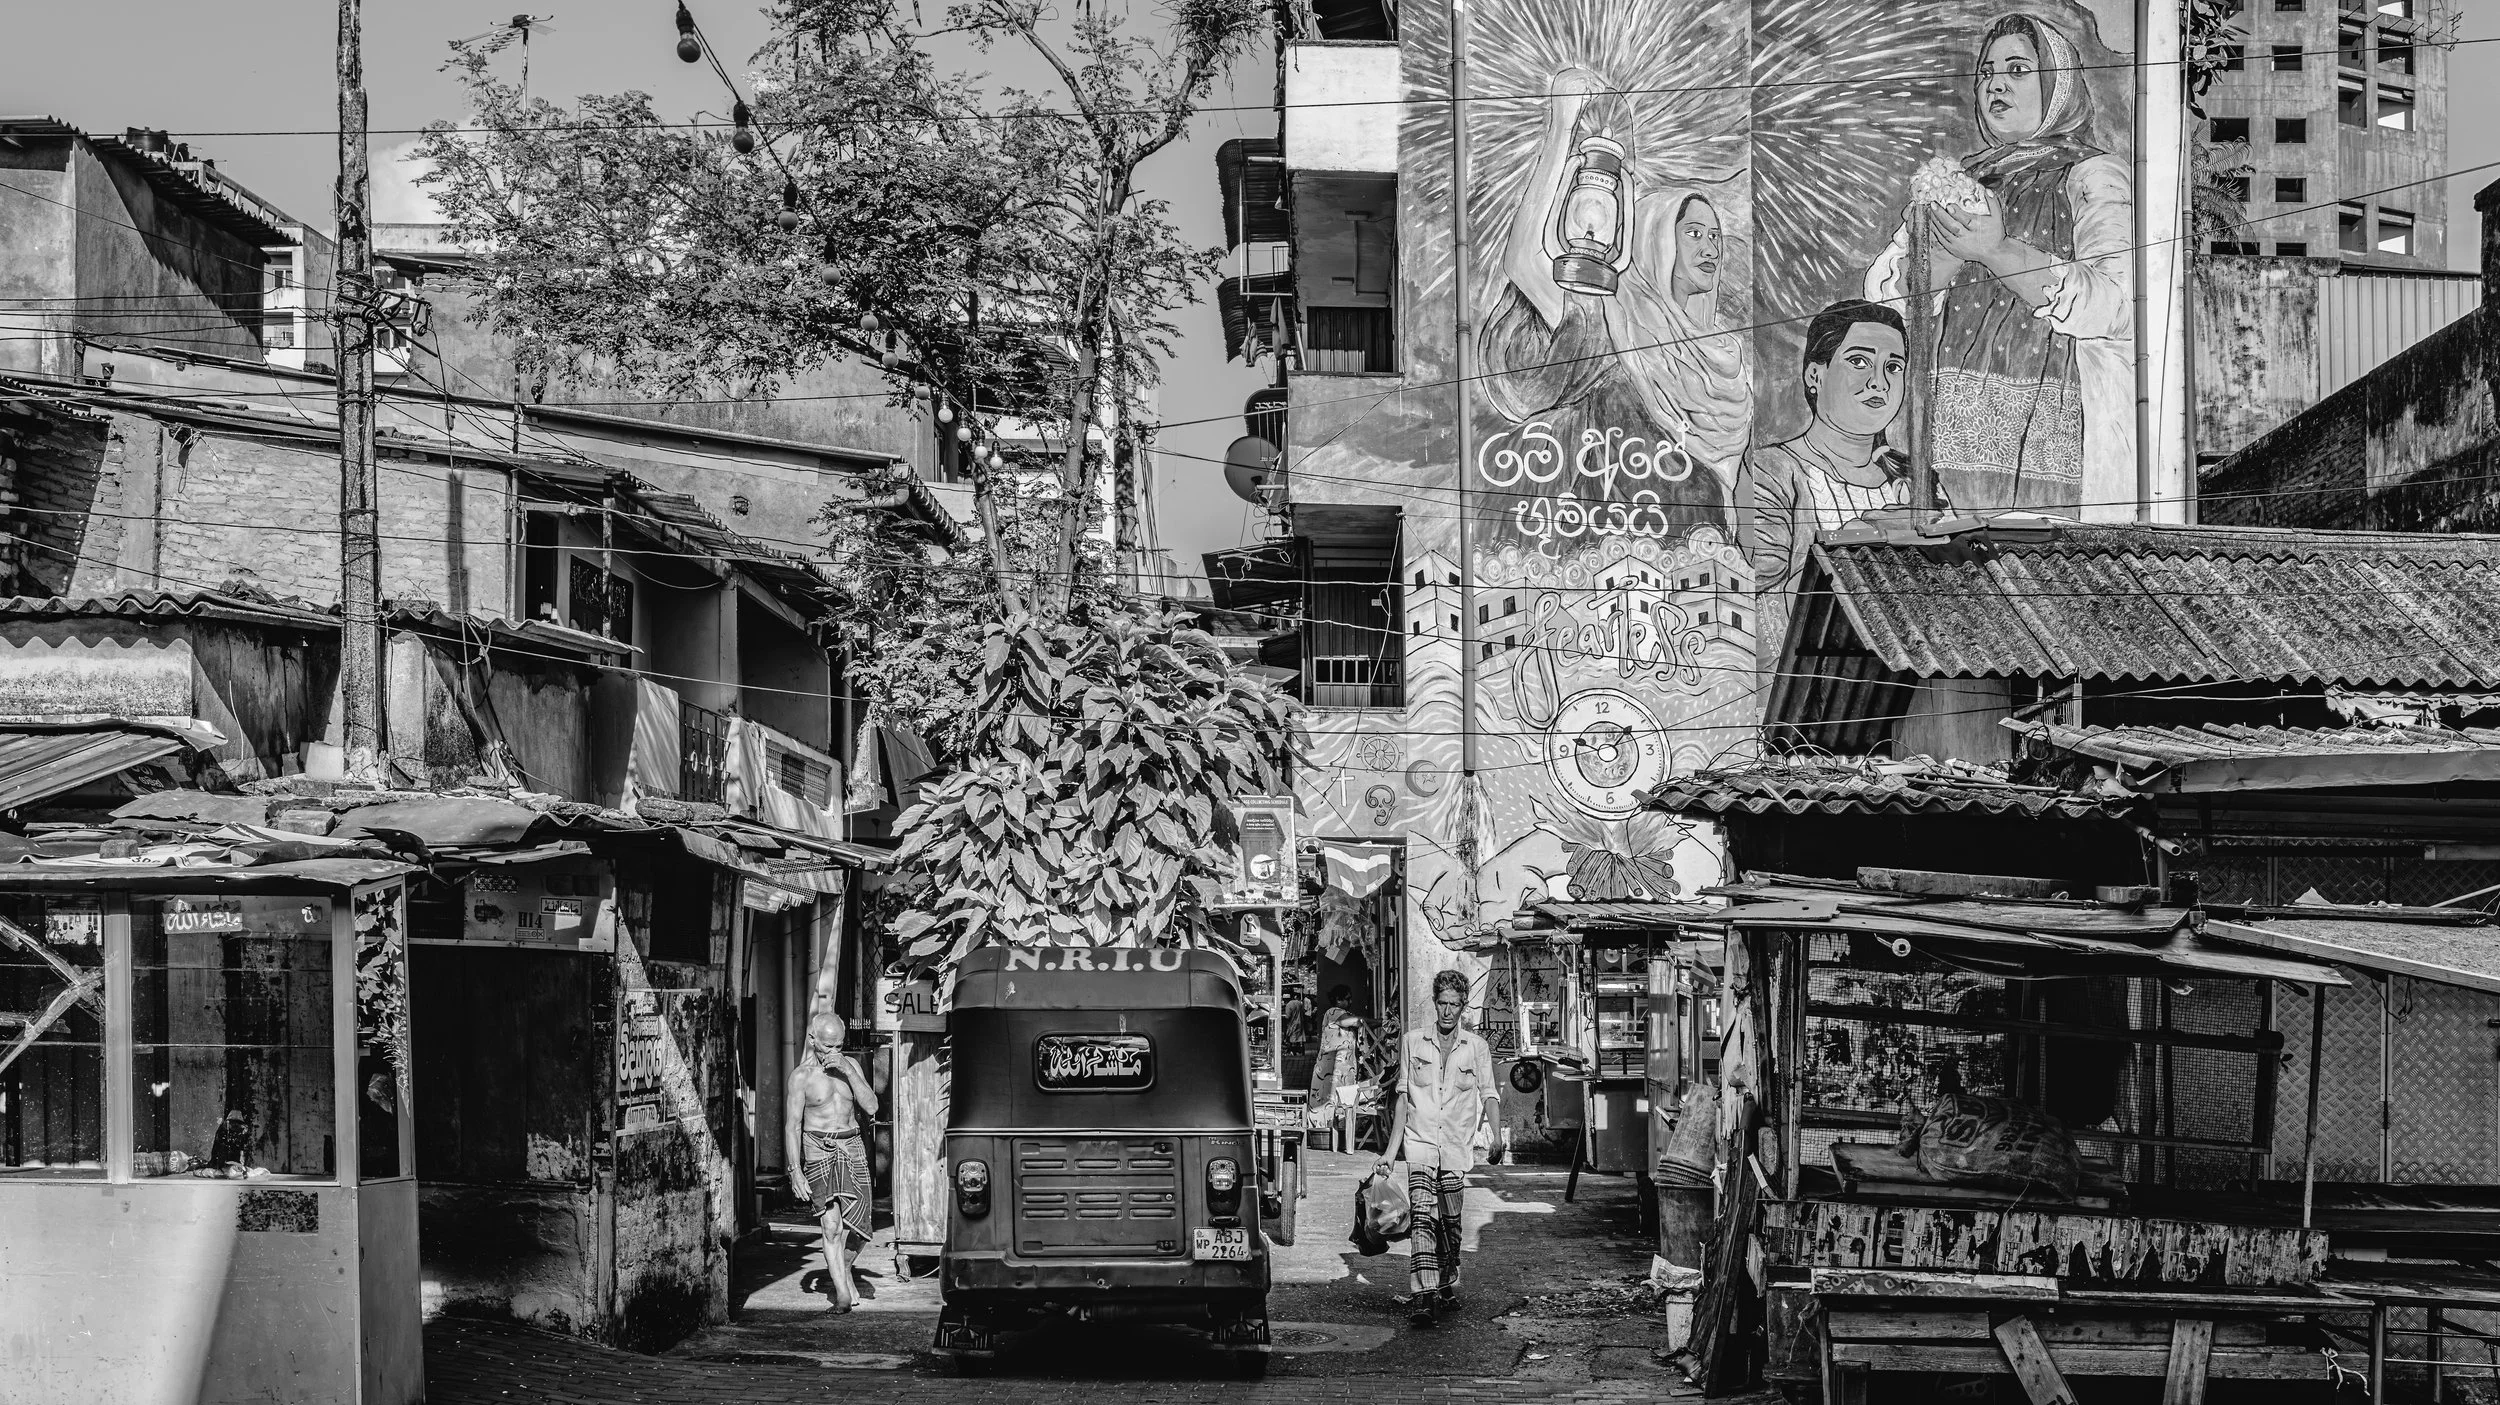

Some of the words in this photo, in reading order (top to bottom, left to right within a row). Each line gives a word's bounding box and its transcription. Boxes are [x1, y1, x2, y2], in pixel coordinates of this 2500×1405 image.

[1478, 421, 1564, 487] මේ
[1576, 420, 1693, 501] අපේ
[1594, 702, 1610, 714] 12
[1559, 745, 1570, 757] 9
[1645, 744, 1655, 756] 3
[1605, 791, 1614, 804] 6
[1196, 1239, 1210, 1249] WP
[1214, 1230, 1243, 1243] ABJ
